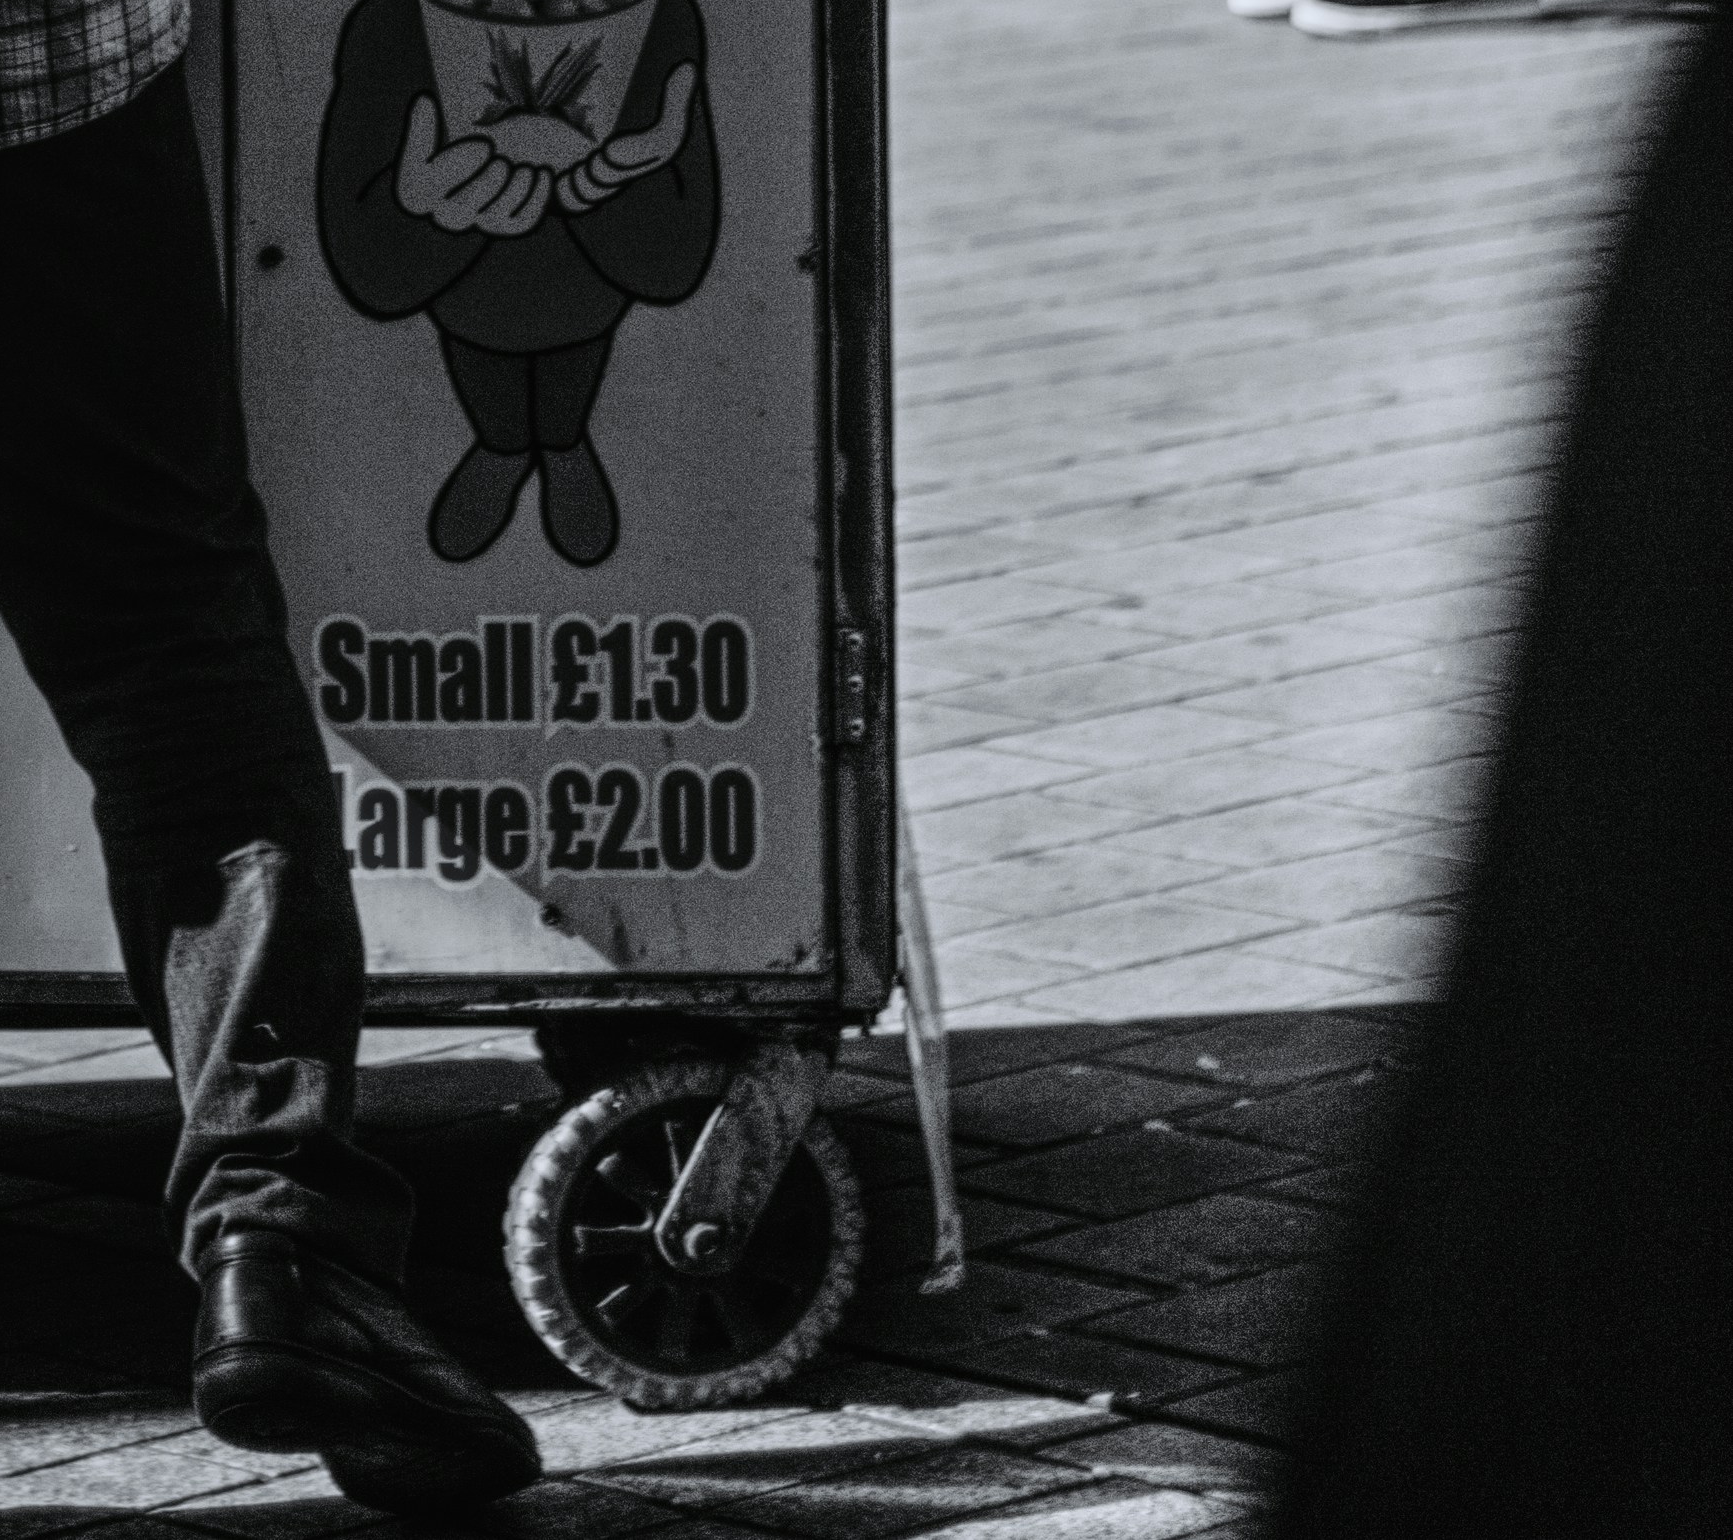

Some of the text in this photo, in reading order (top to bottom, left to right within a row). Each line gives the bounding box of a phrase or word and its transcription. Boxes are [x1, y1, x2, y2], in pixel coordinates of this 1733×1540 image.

[318, 619, 748, 723] Small £1.30
[331, 766, 756, 882] arge £2.00
